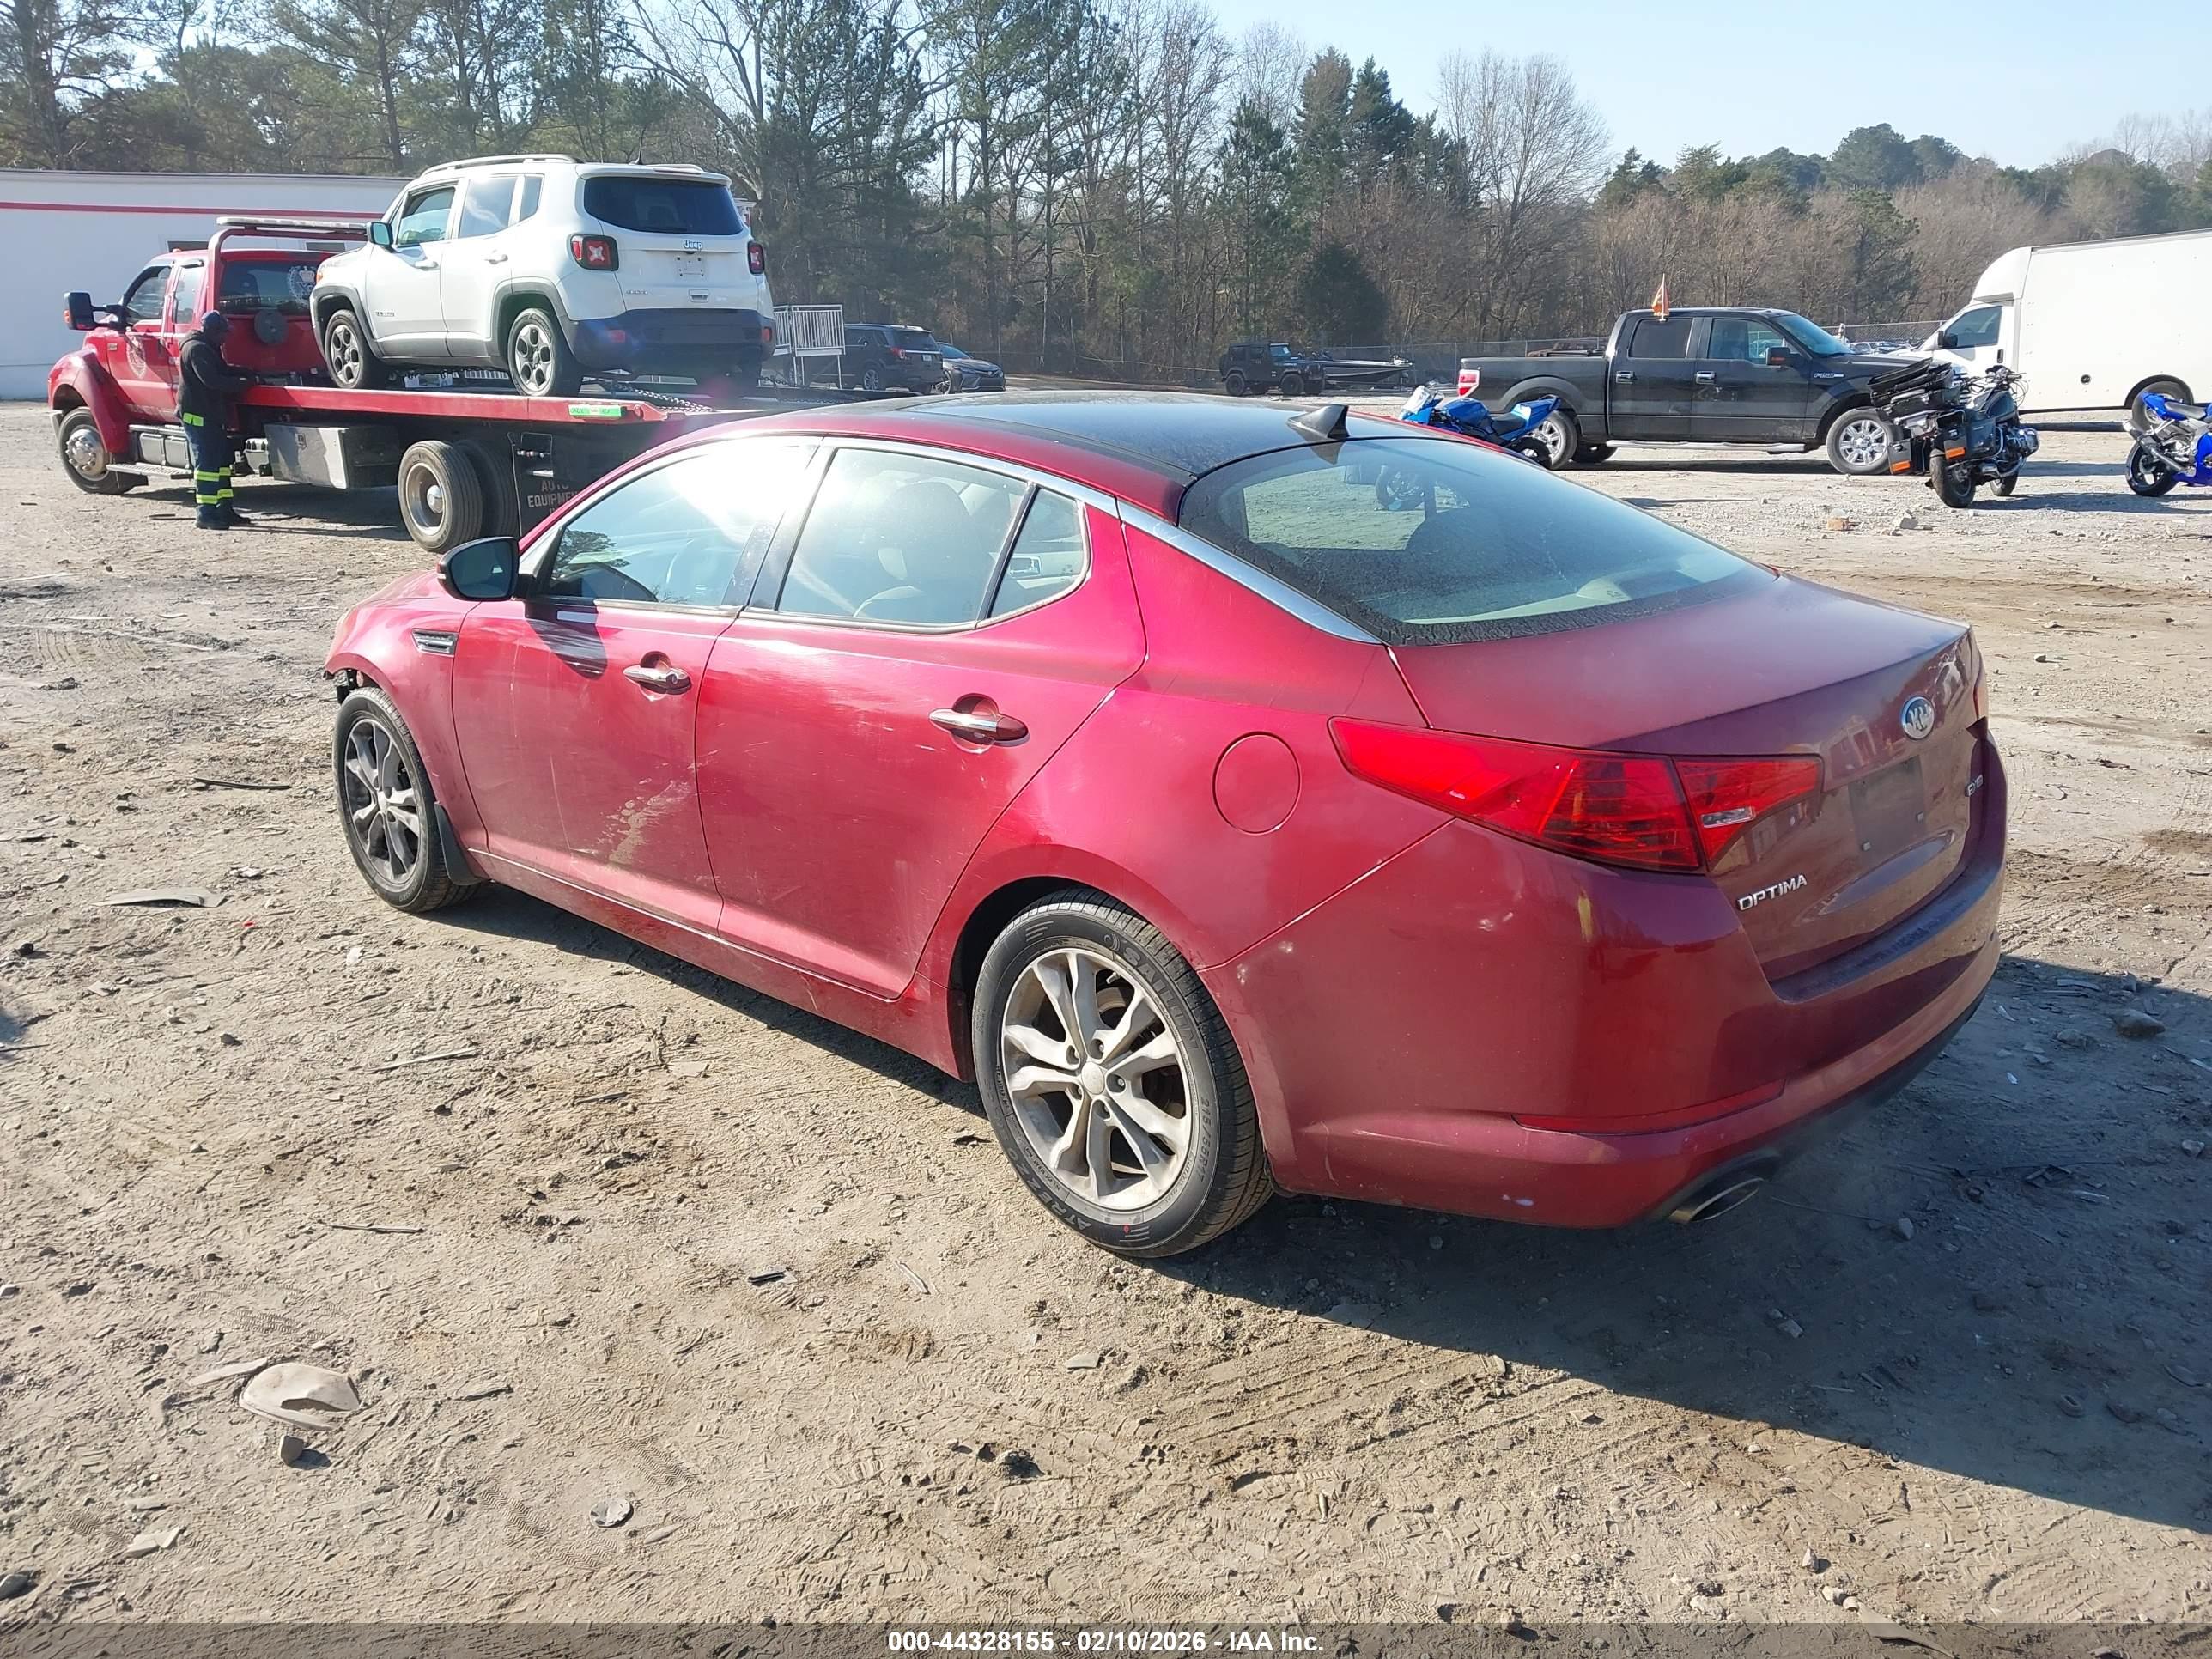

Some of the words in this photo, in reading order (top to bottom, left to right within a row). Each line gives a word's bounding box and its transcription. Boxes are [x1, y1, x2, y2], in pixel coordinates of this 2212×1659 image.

[684, 240, 702, 250] Jeep
[1737, 874, 1808, 910] OPTIMA
[1123, 947, 1199, 1049] SAILUN
